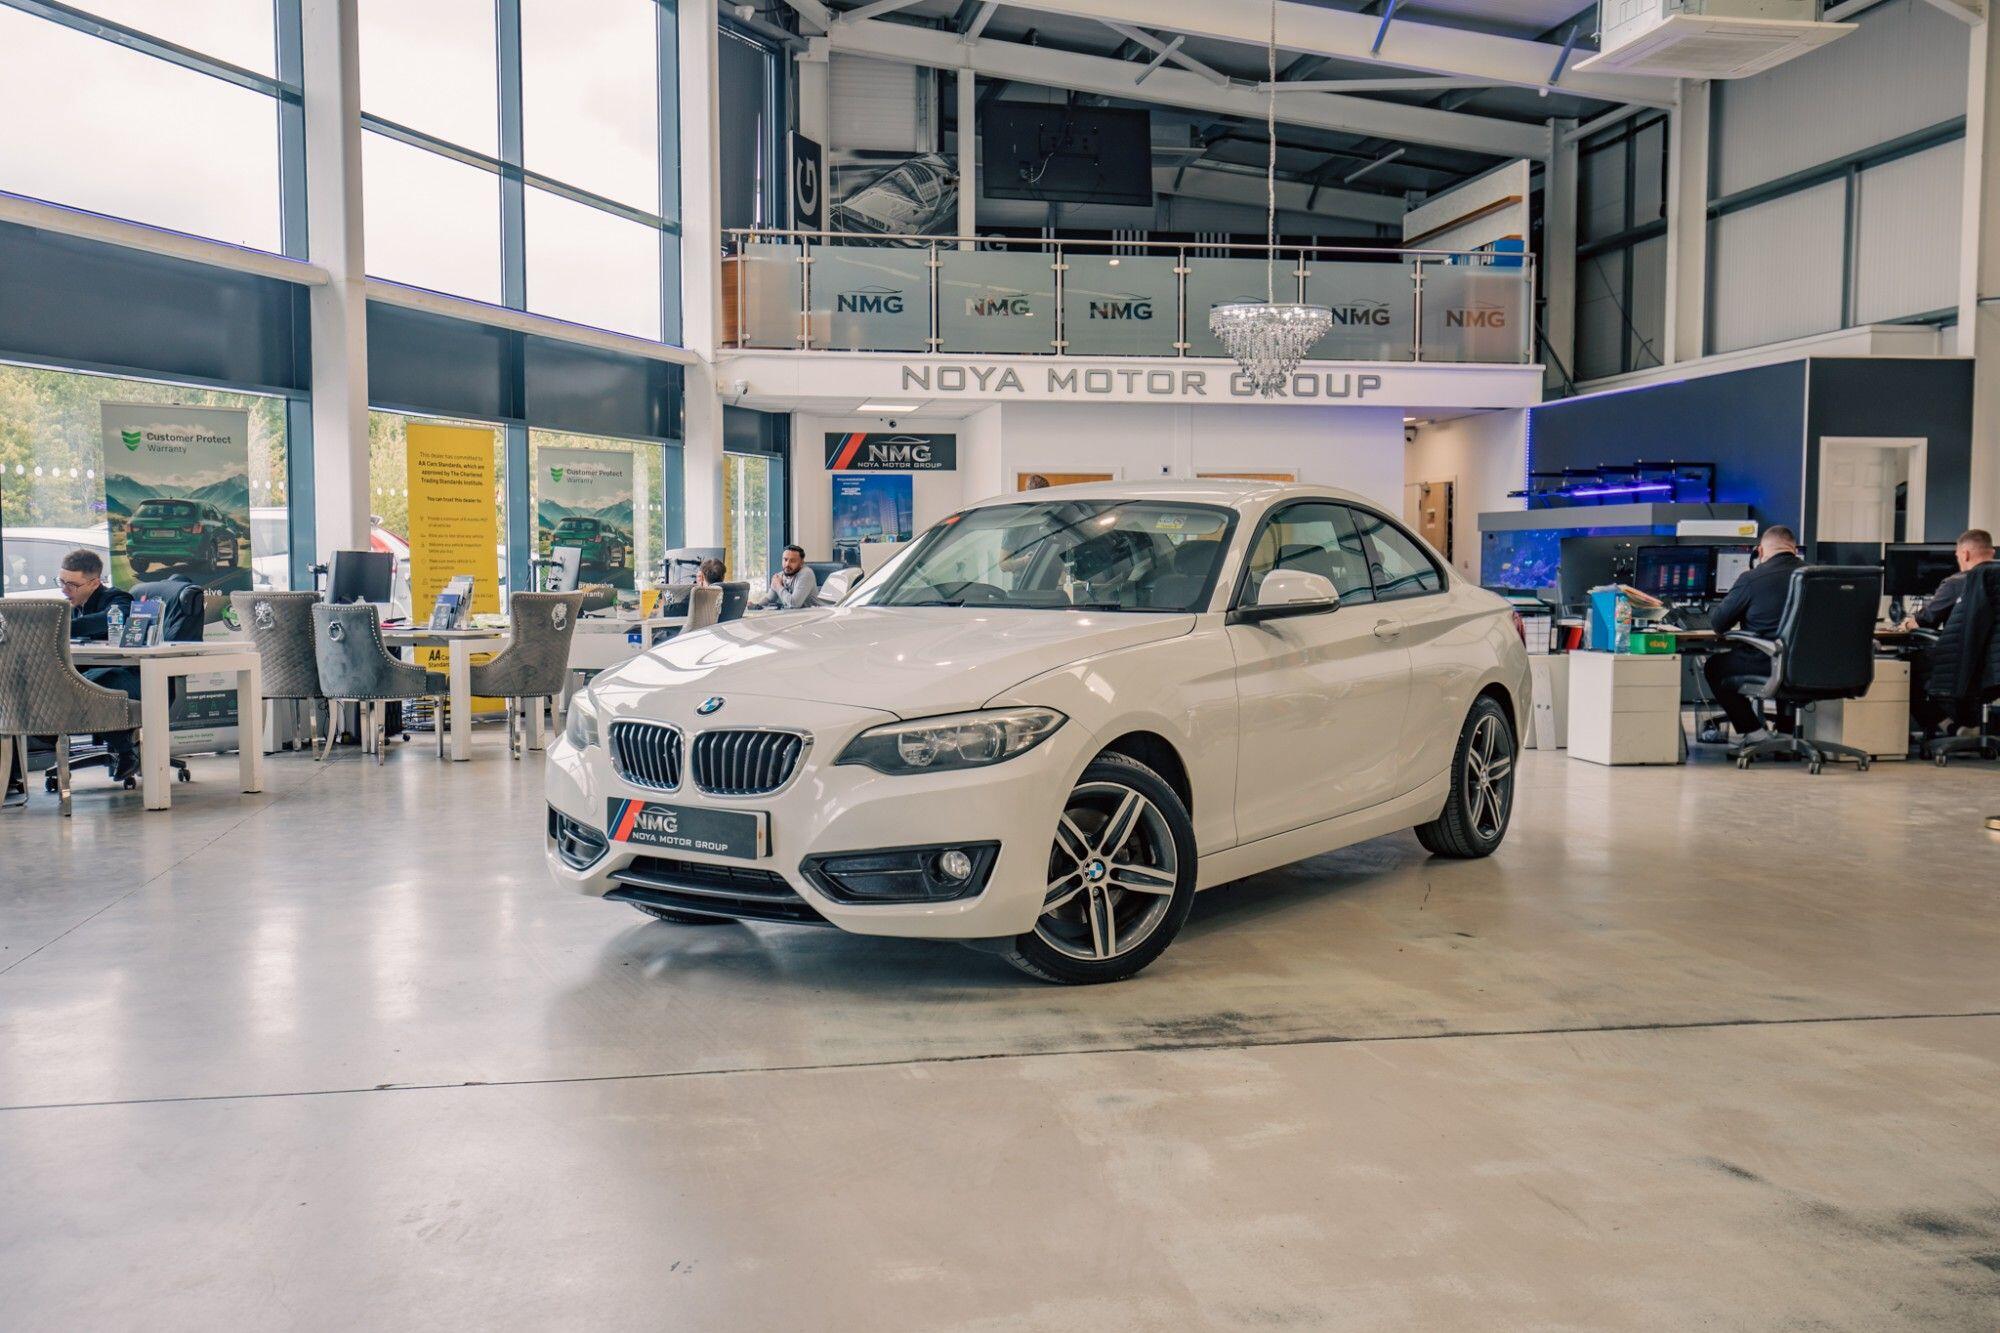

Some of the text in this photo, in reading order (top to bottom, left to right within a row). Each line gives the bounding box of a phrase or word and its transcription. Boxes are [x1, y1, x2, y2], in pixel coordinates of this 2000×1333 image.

[837, 295, 904, 314] NMG
[965, 298, 1030, 316] NMG
[1089, 302, 1153, 320] NMG
[1331, 308, 1390, 326] NMG
[1446, 310, 1506, 328] NMG
[902, 365, 1025, 393] NOYA
[1048, 367, 1207, 395] MOTOR
[147, 432, 231, 444] Customer Protect
[147, 444, 187, 454] Warranty
[868, 444, 932, 463] NMG
[566, 468, 623, 478] Customer Protect
[428, 650, 440, 661] AA
[633, 812, 678, 833] NMG
[632, 832, 728, 851] NOYA MOTOR GROUP
